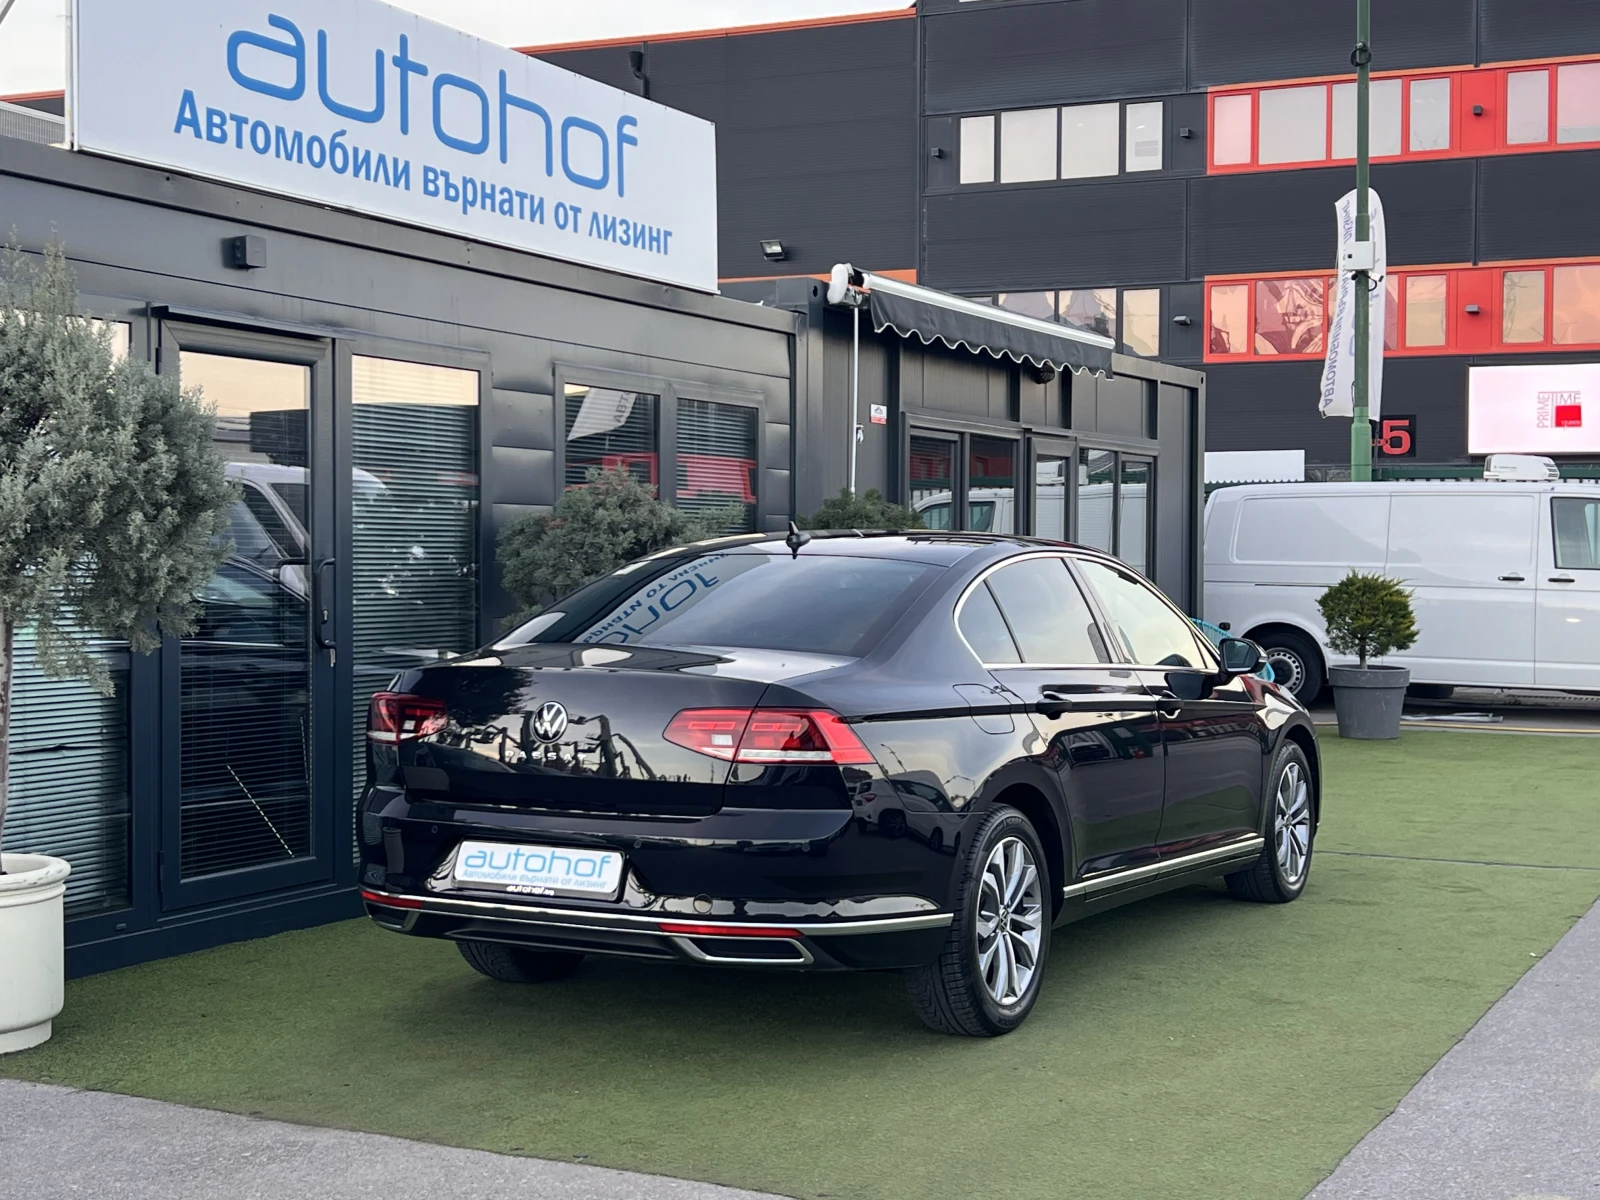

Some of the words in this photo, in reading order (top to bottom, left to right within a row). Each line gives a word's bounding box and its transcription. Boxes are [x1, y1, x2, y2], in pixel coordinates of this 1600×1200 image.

[227, 13, 638, 198] autohof
[173, 88, 410, 191] Автомобили
[423, 164, 545, 225] върнати
[554, 201, 582, 234] от
[588, 211, 673, 256] лизинг
[1537, 393, 1550, 428] PRIME
[1383, 420, 1411, 455] 5
[505, 750, 587, 766] PASSAT
[462, 869, 517, 882] Автомобили
[519, 873, 559, 886] върнати
[561, 877, 572, 886] от
[573, 878, 607, 889] лизинг
[464, 847, 612, 878] autohof
